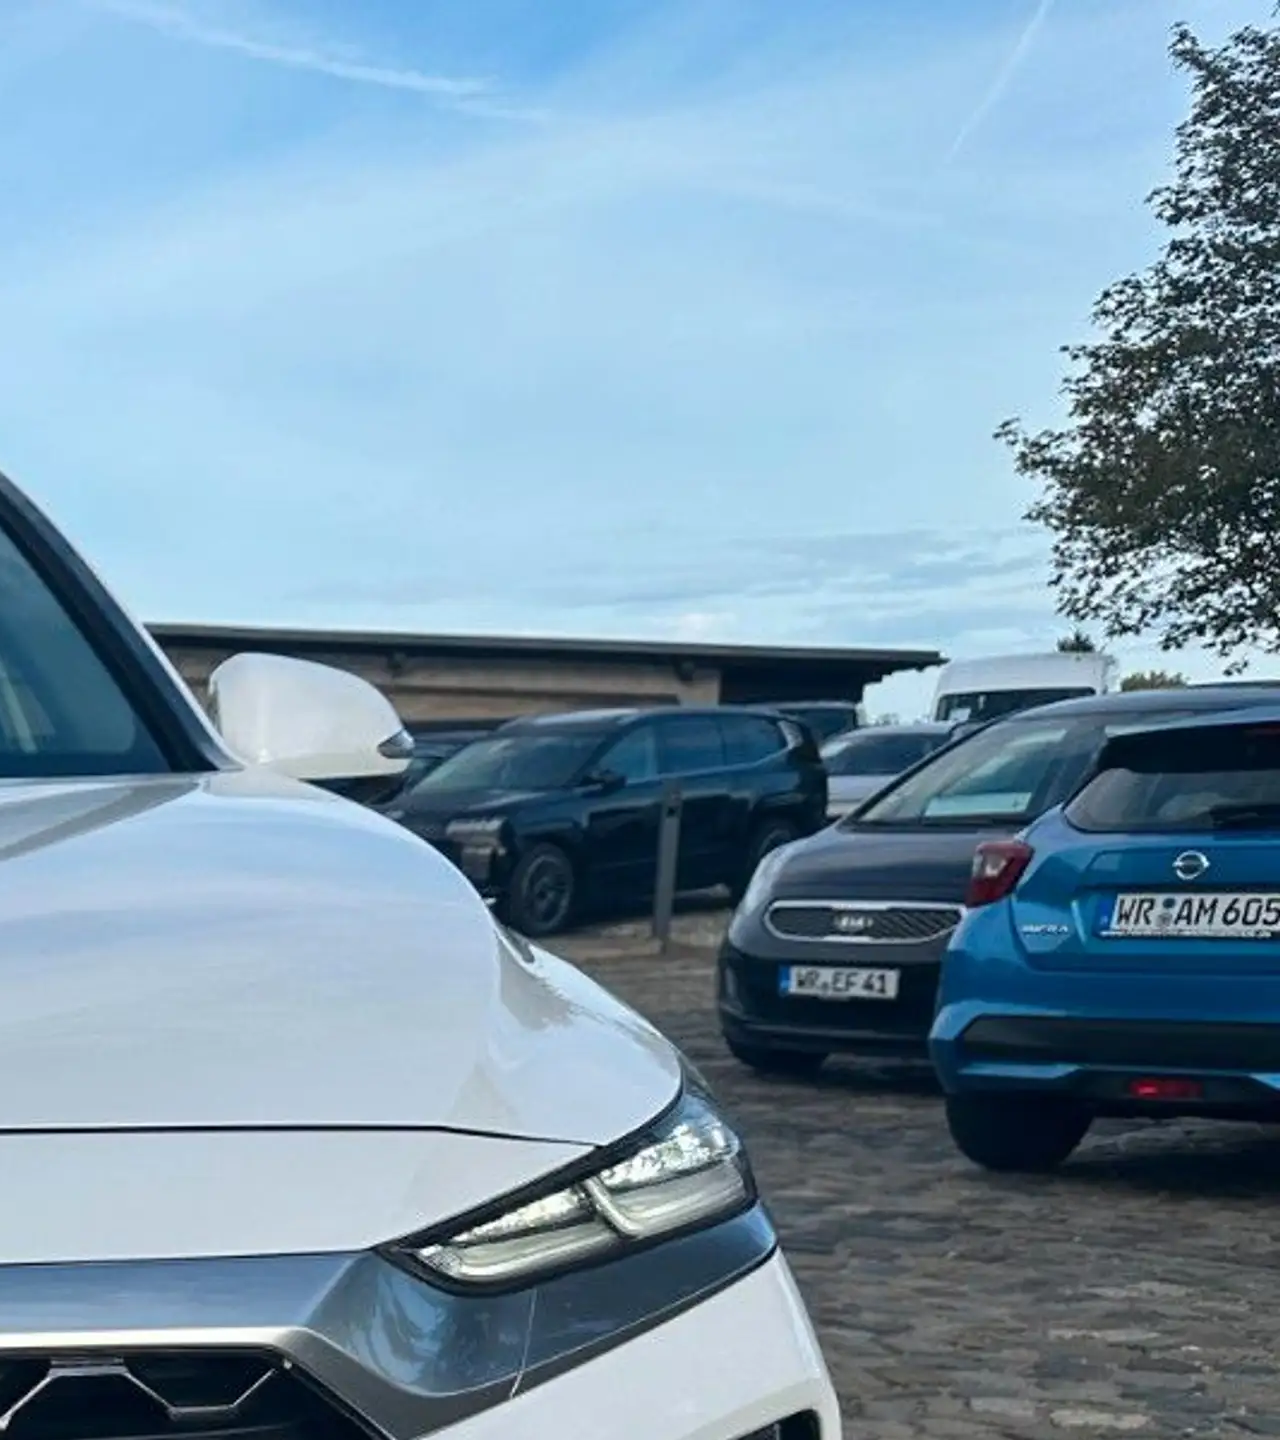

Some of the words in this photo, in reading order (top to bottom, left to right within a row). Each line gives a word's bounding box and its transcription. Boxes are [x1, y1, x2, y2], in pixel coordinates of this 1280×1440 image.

[1117, 898, 1155, 925] WR
[1174, 898, 1219, 925] AM
[1222, 898, 1280, 926] 605
[831, 970, 860, 993] EF
[861, 972, 887, 994] 41
